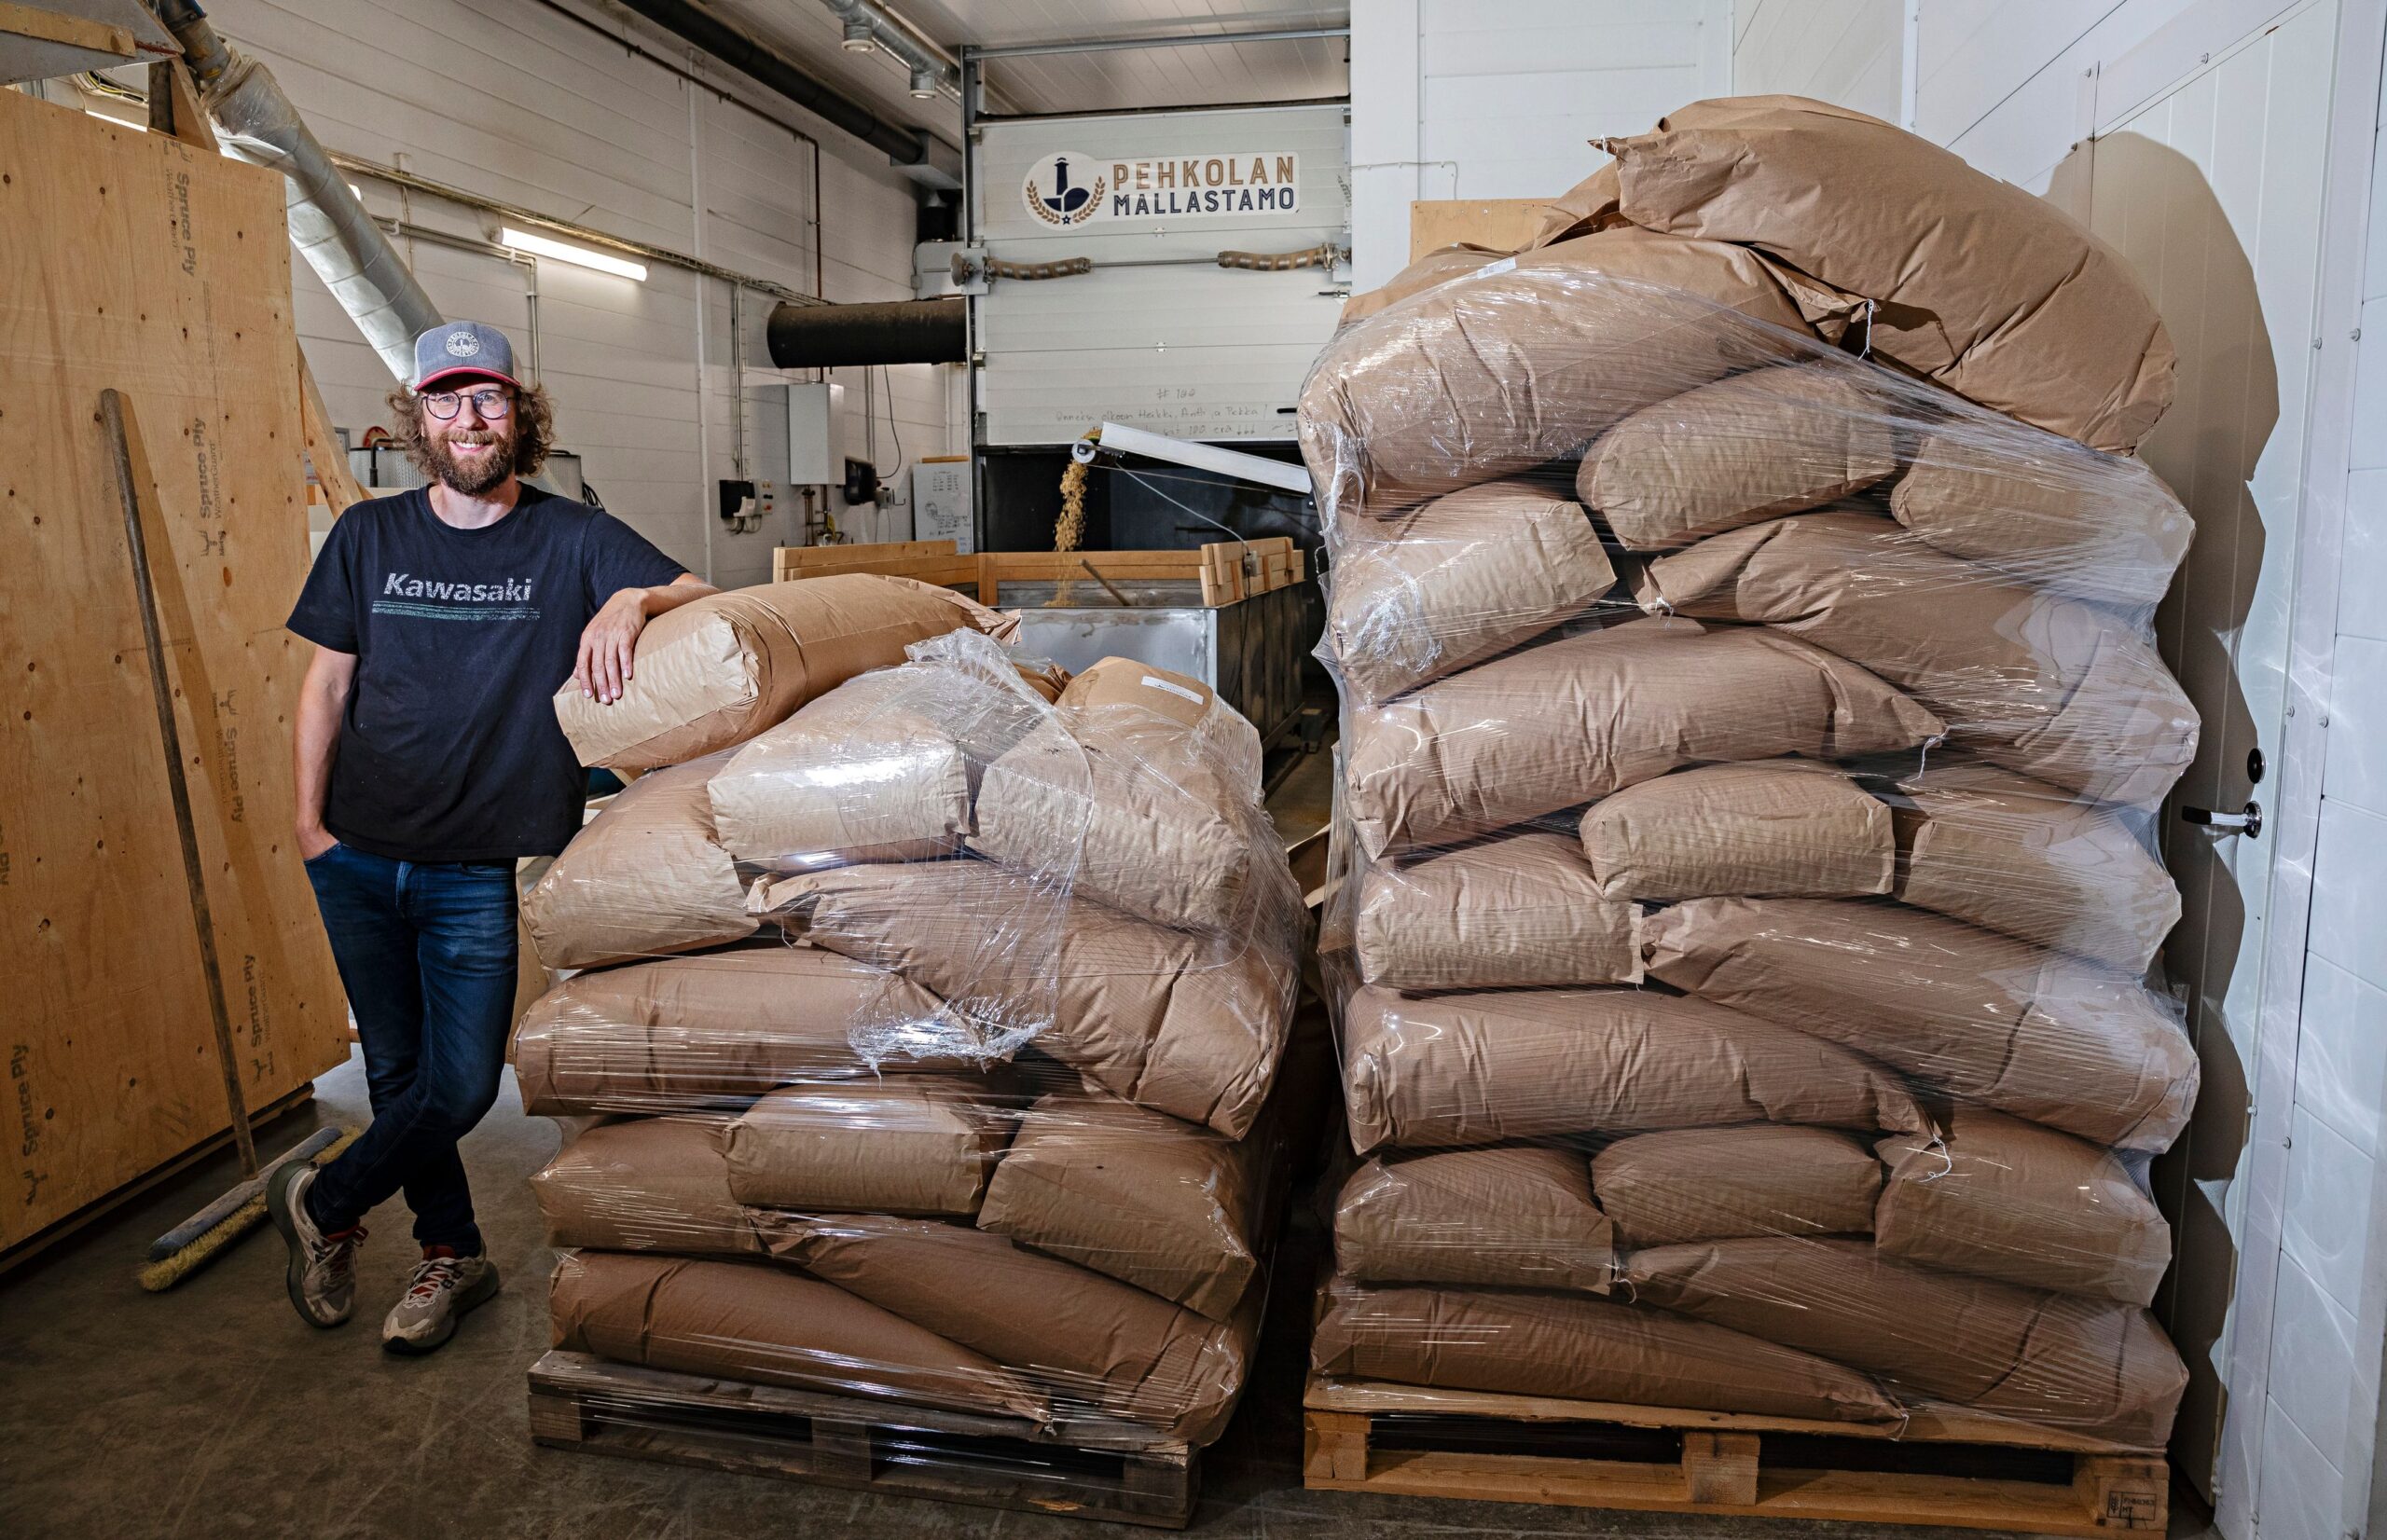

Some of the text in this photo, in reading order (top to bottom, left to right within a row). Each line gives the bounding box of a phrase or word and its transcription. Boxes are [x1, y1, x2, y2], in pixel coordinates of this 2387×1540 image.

[1112, 156, 1294, 191] PEHKOLAN
[1113, 187, 1295, 216] MALLASTAMO
[175, 172, 197, 278] Spruce Ply
[193, 418, 213, 519] Spruce Ply
[383, 572, 532, 602] Kawasaki
[224, 727, 244, 822] Spruce Ply
[242, 954, 263, 1049] Spruce Ply
[10, 1044, 40, 1157] Spruce Ply
